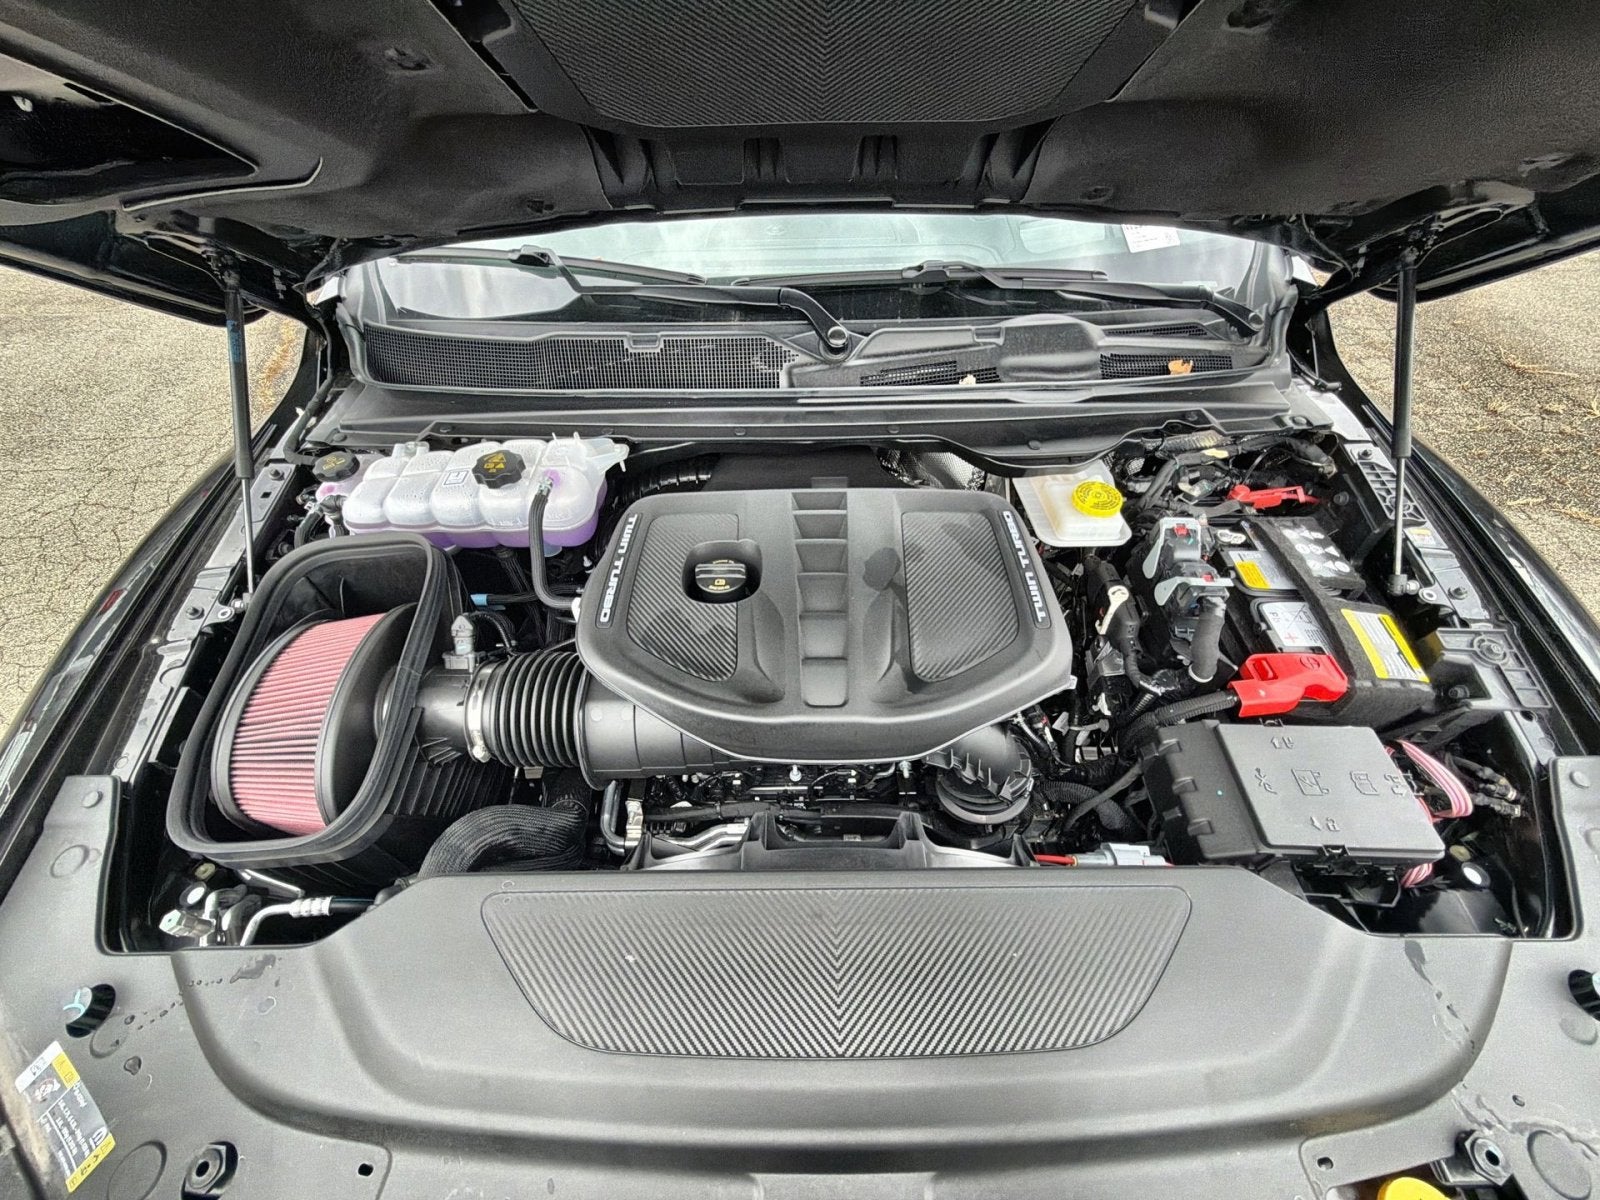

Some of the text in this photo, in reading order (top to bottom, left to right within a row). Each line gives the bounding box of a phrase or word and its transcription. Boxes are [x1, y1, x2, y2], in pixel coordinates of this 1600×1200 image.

[599, 513, 638, 623] TWIN TURBO
[1002, 510, 1047, 623] TWIN TURBO
